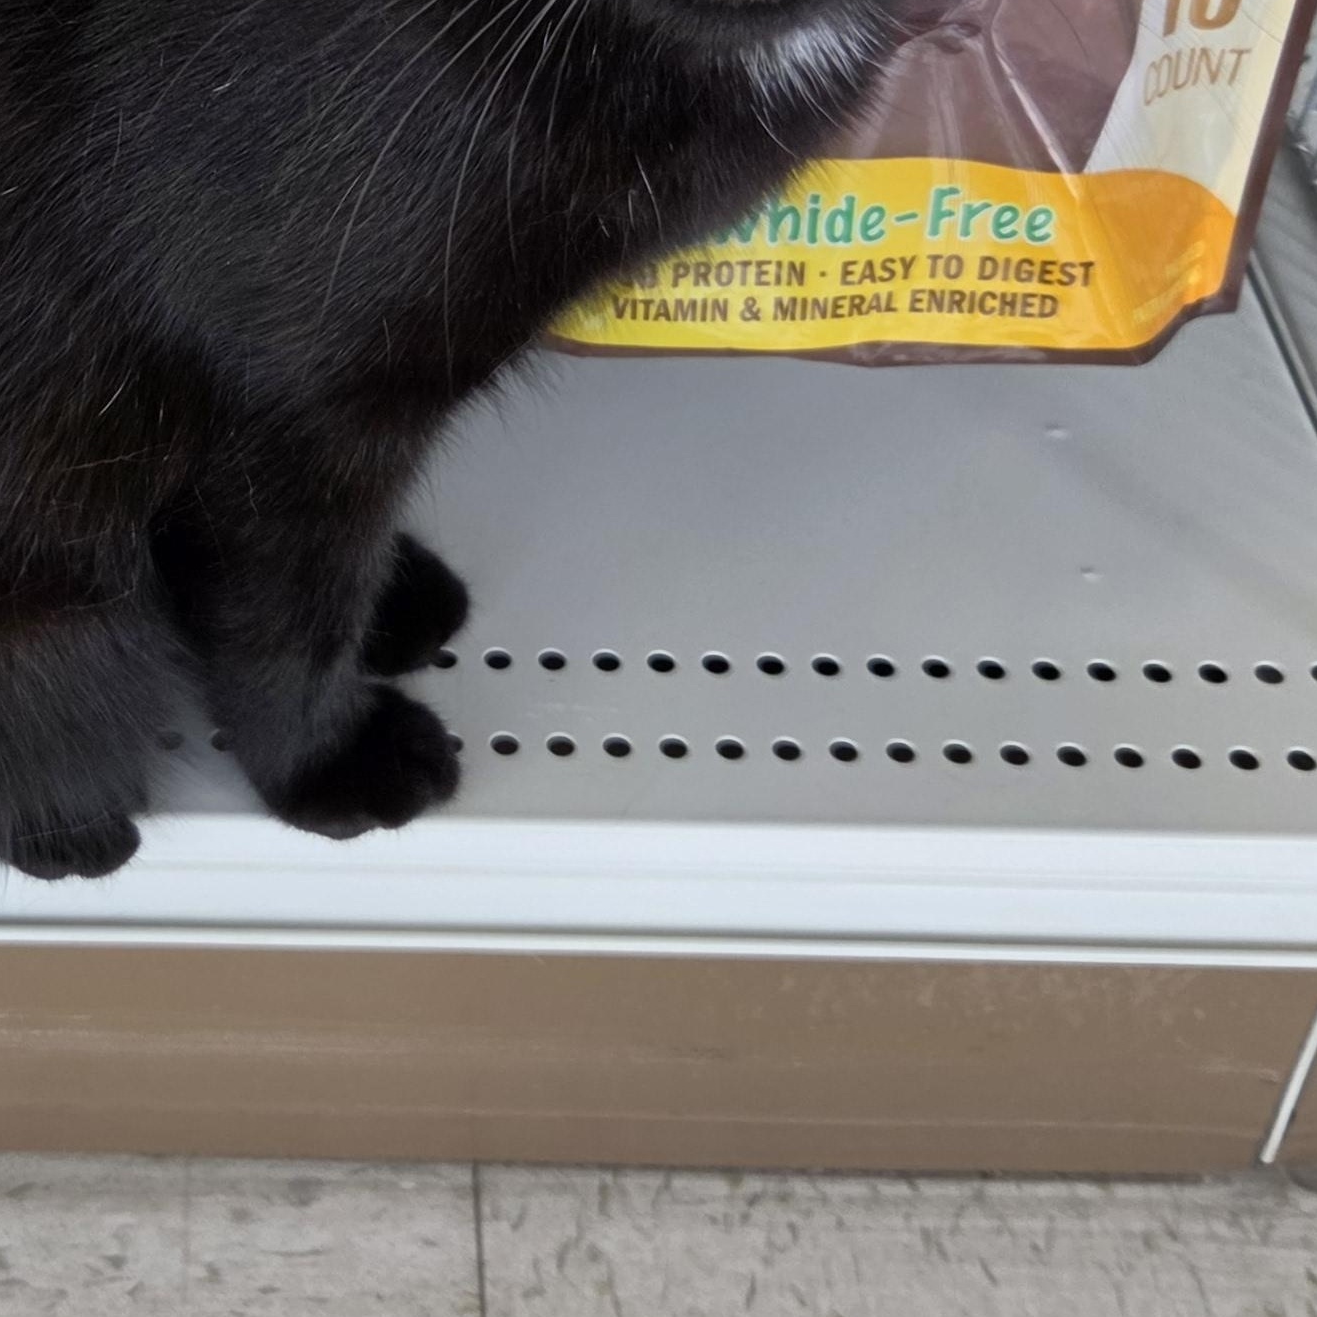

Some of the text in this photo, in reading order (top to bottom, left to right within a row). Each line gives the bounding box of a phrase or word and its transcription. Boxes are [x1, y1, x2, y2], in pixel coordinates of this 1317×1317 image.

[1143, 47, 1253, 107] COUNT
[671, 259, 806, 288] PROTEIN
[839, 257, 915, 284] EASY
[926, 253, 965, 281] TO
[978, 257, 1096, 287] DIGEST
[612, 288, 1059, 322] VITAMIN & MINERAL ENRICHED
